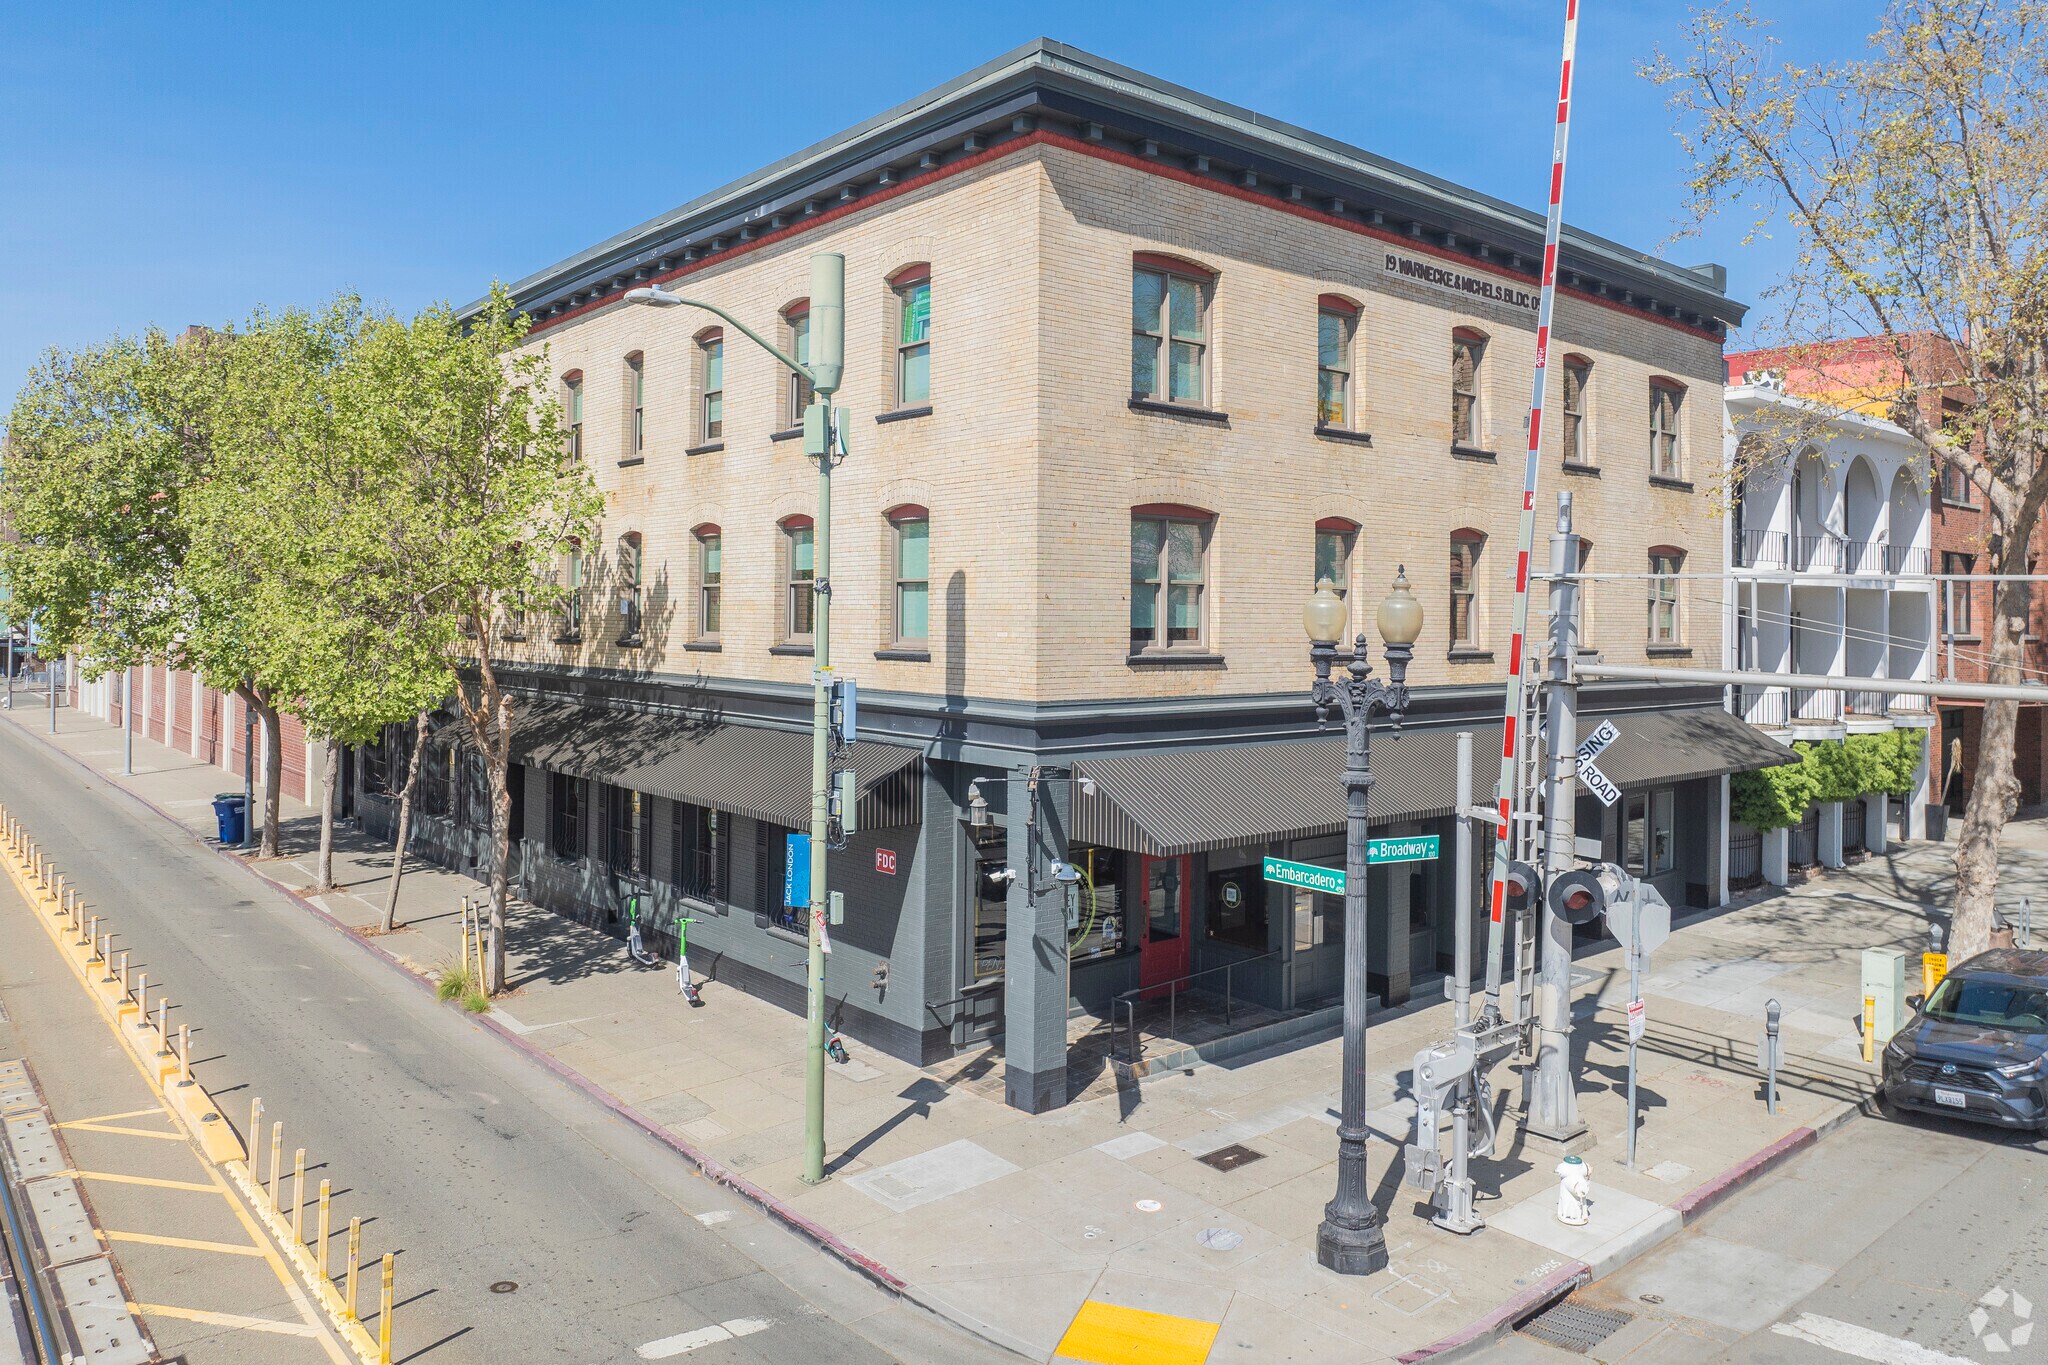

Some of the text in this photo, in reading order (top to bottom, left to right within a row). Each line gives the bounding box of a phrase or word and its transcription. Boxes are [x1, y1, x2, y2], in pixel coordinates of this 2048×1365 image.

[1454, 275, 1461, 290] &
[1575, 727, 1613, 768] SSING
[1582, 766, 1617, 802] ROAD
[877, 852, 895, 870] FDC
[1380, 842, 1428, 857] Broadway
[784, 843, 794, 906] JACK LONDON
[1275, 864, 1336, 889] Embarcadero
